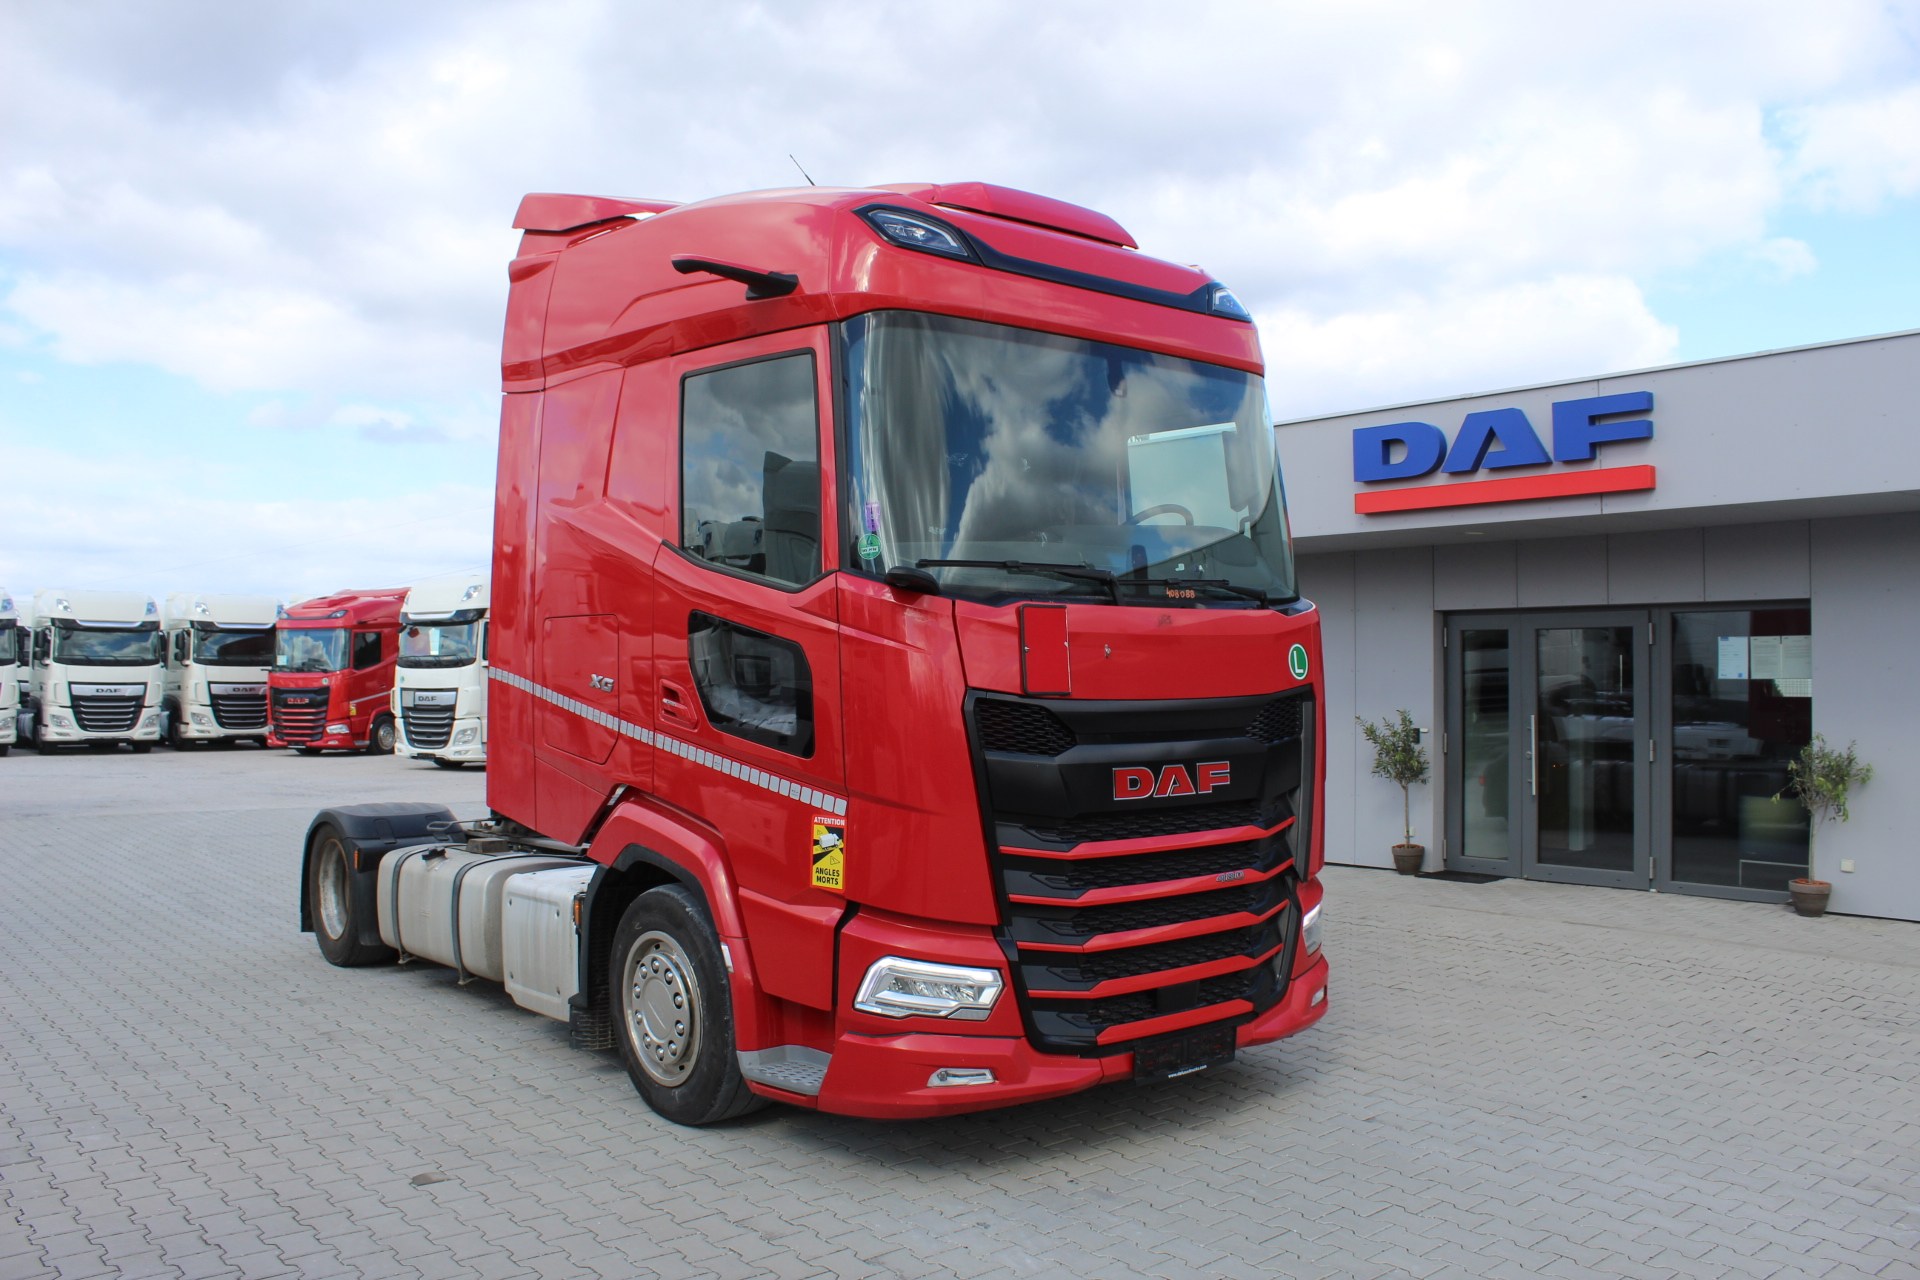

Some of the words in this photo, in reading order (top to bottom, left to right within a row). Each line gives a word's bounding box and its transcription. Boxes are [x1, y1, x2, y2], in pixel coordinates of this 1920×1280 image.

[1353, 391, 1653, 482] DAF
[1293, 650, 1304, 674] L
[590, 673, 615, 693] XG
[1112, 760, 1231, 801] DAF
[813, 816, 845, 826] ATTENTION
[815, 867, 840, 877] ANGLES
[1215, 871, 1245, 882] 480
[816, 875, 839, 885] MORTS
